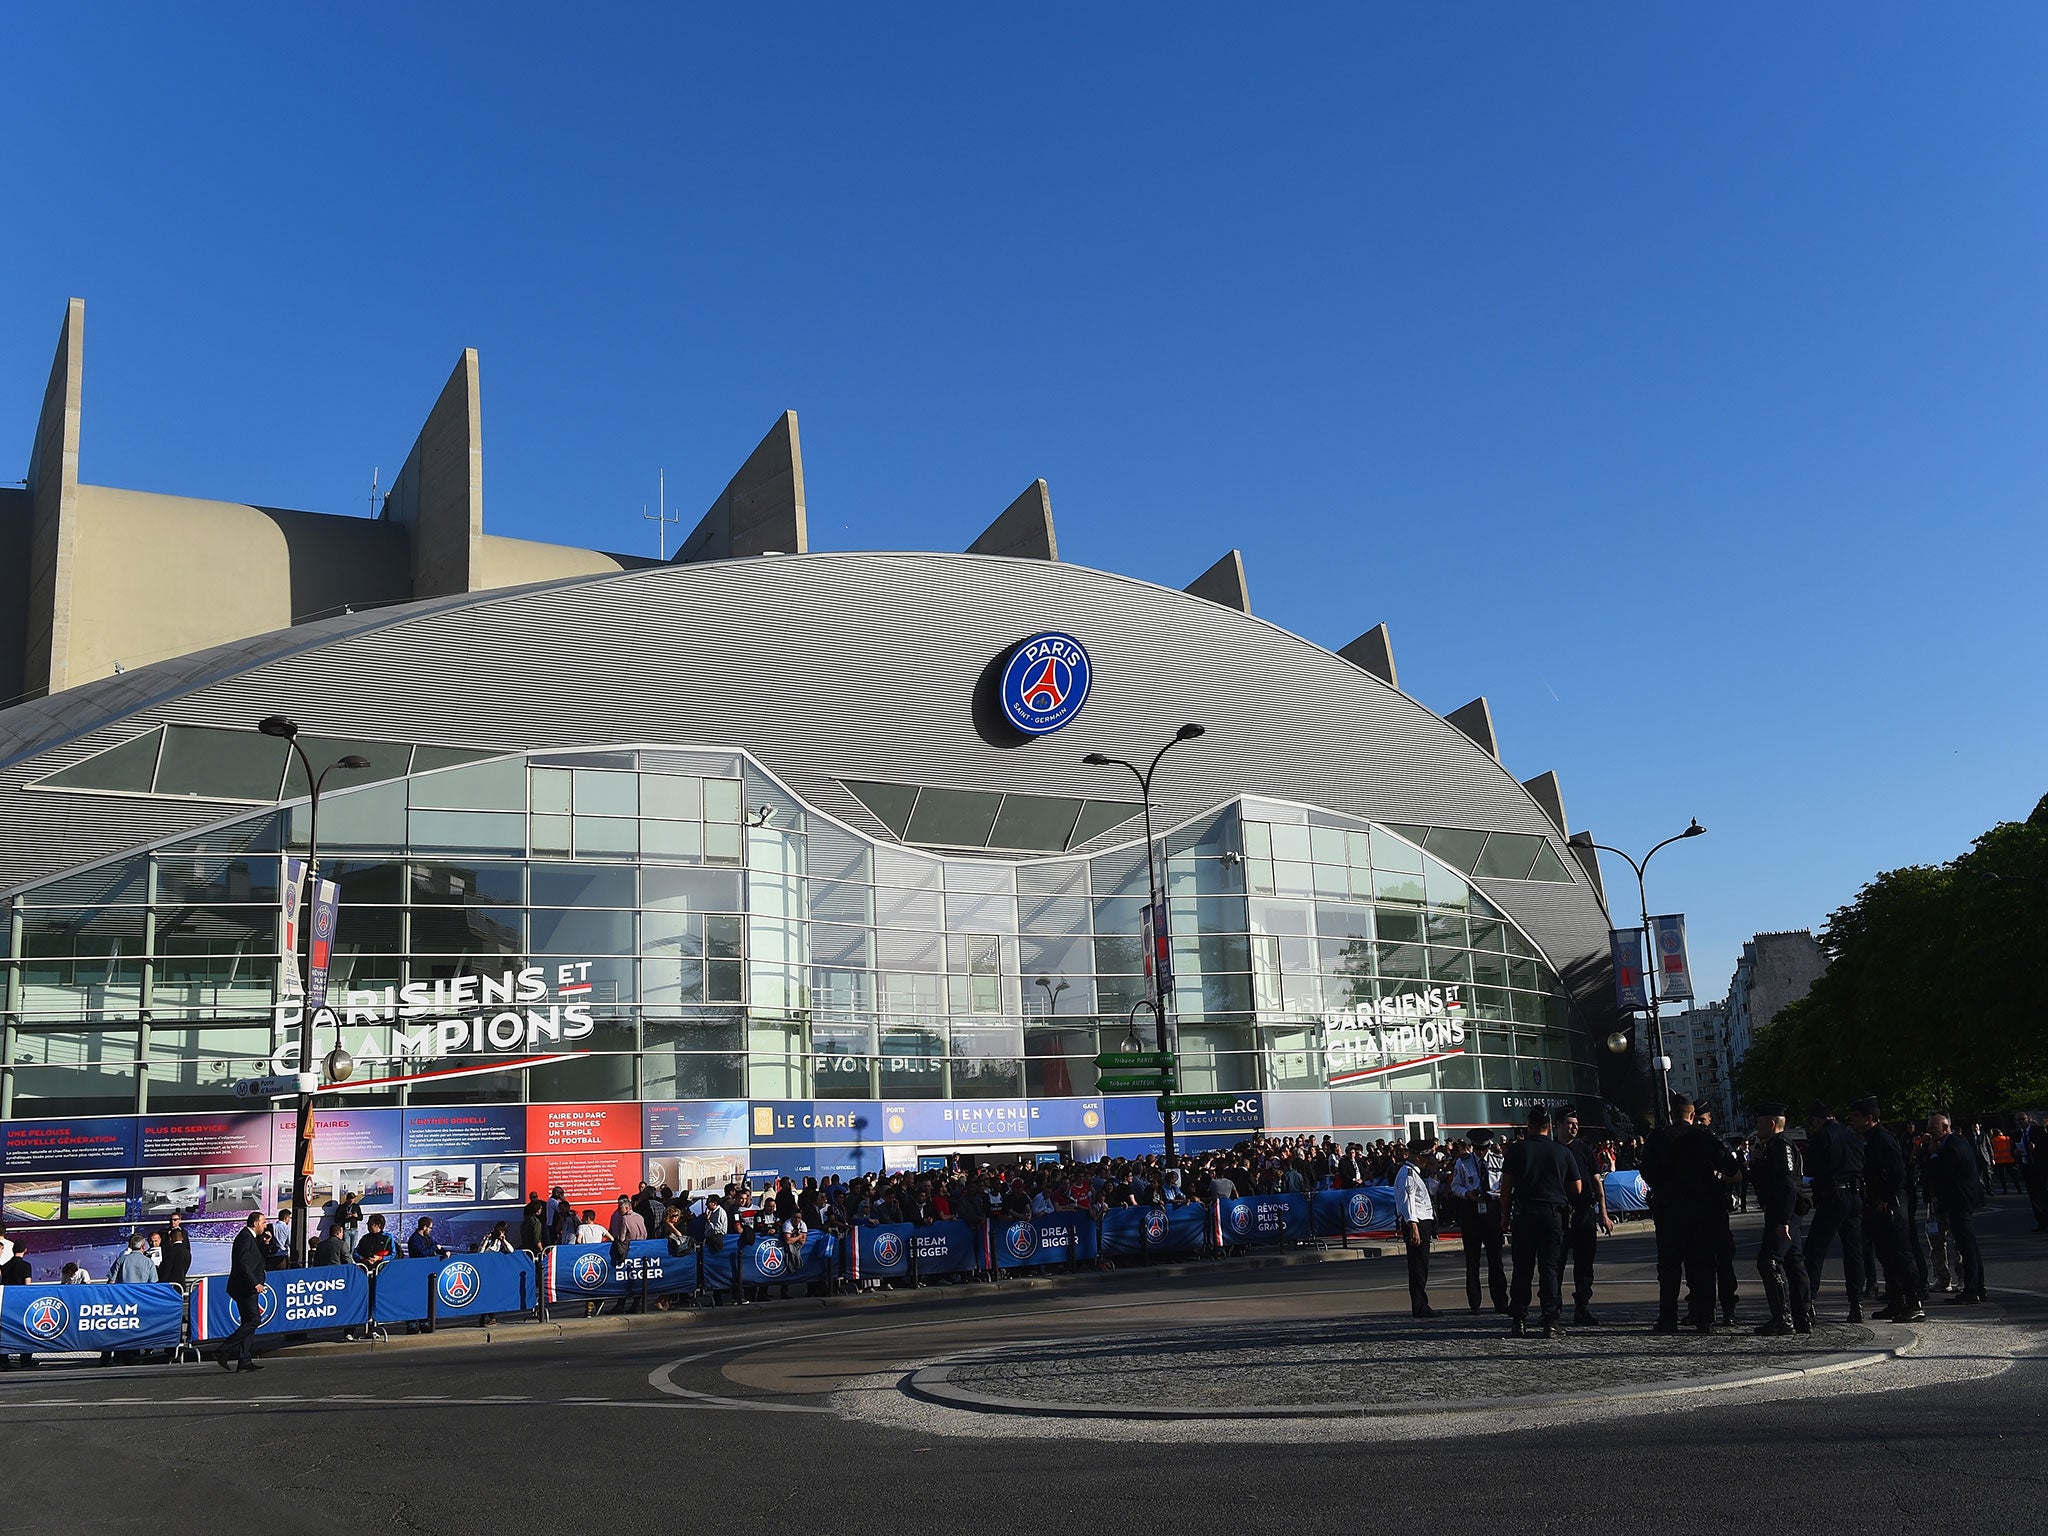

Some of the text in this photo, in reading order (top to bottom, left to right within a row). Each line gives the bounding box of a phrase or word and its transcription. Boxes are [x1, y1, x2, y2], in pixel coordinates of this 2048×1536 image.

[1026, 642, 1080, 667] PARIS
[1013, 702, 1067, 723] SAINT GERMAIN
[275, 962, 593, 1034] PARISIENS ET
[1325, 985, 1460, 1035] PARISIENS ET
[1327, 1017, 1465, 1068] CHAMPIONS
[891, 1058, 941, 1072] PLUS
[1503, 1098, 1512, 1107] LE
[1514, 1098, 1532, 1107] PARC
[1533, 1099, 1545, 1107] DES
[778, 1112, 856, 1128] LE CARRÉ
[944, 1107, 1040, 1121] BIENVENUE
[1088, 1115, 1094, 1123] L
[409, 1117, 448, 1125] L'ENTRÉE
[893, 1120, 900, 1129] L
[958, 1121, 1026, 1133] WELCOME
[185, 1125, 230, 1133] SERVICES
[7, 1136, 117, 1146] NOUVELLE GÉNÉRATION
[1011, 1223, 1031, 1232] PARIS
[879, 1235, 897, 1243] PARIS
[761, 1241, 776, 1250] PAR
[580, 1255, 601, 1264] PARIS
[445, 1264, 472, 1276] PARIS
[286, 1279, 345, 1294] RÊVONS
[33, 1300, 62, 1310] PARIS
[286, 1294, 324, 1308] PLUS
[79, 1304, 138, 1317] DREAM
[286, 1305, 337, 1320] GRAND
[78, 1317, 140, 1331] BIGGER
